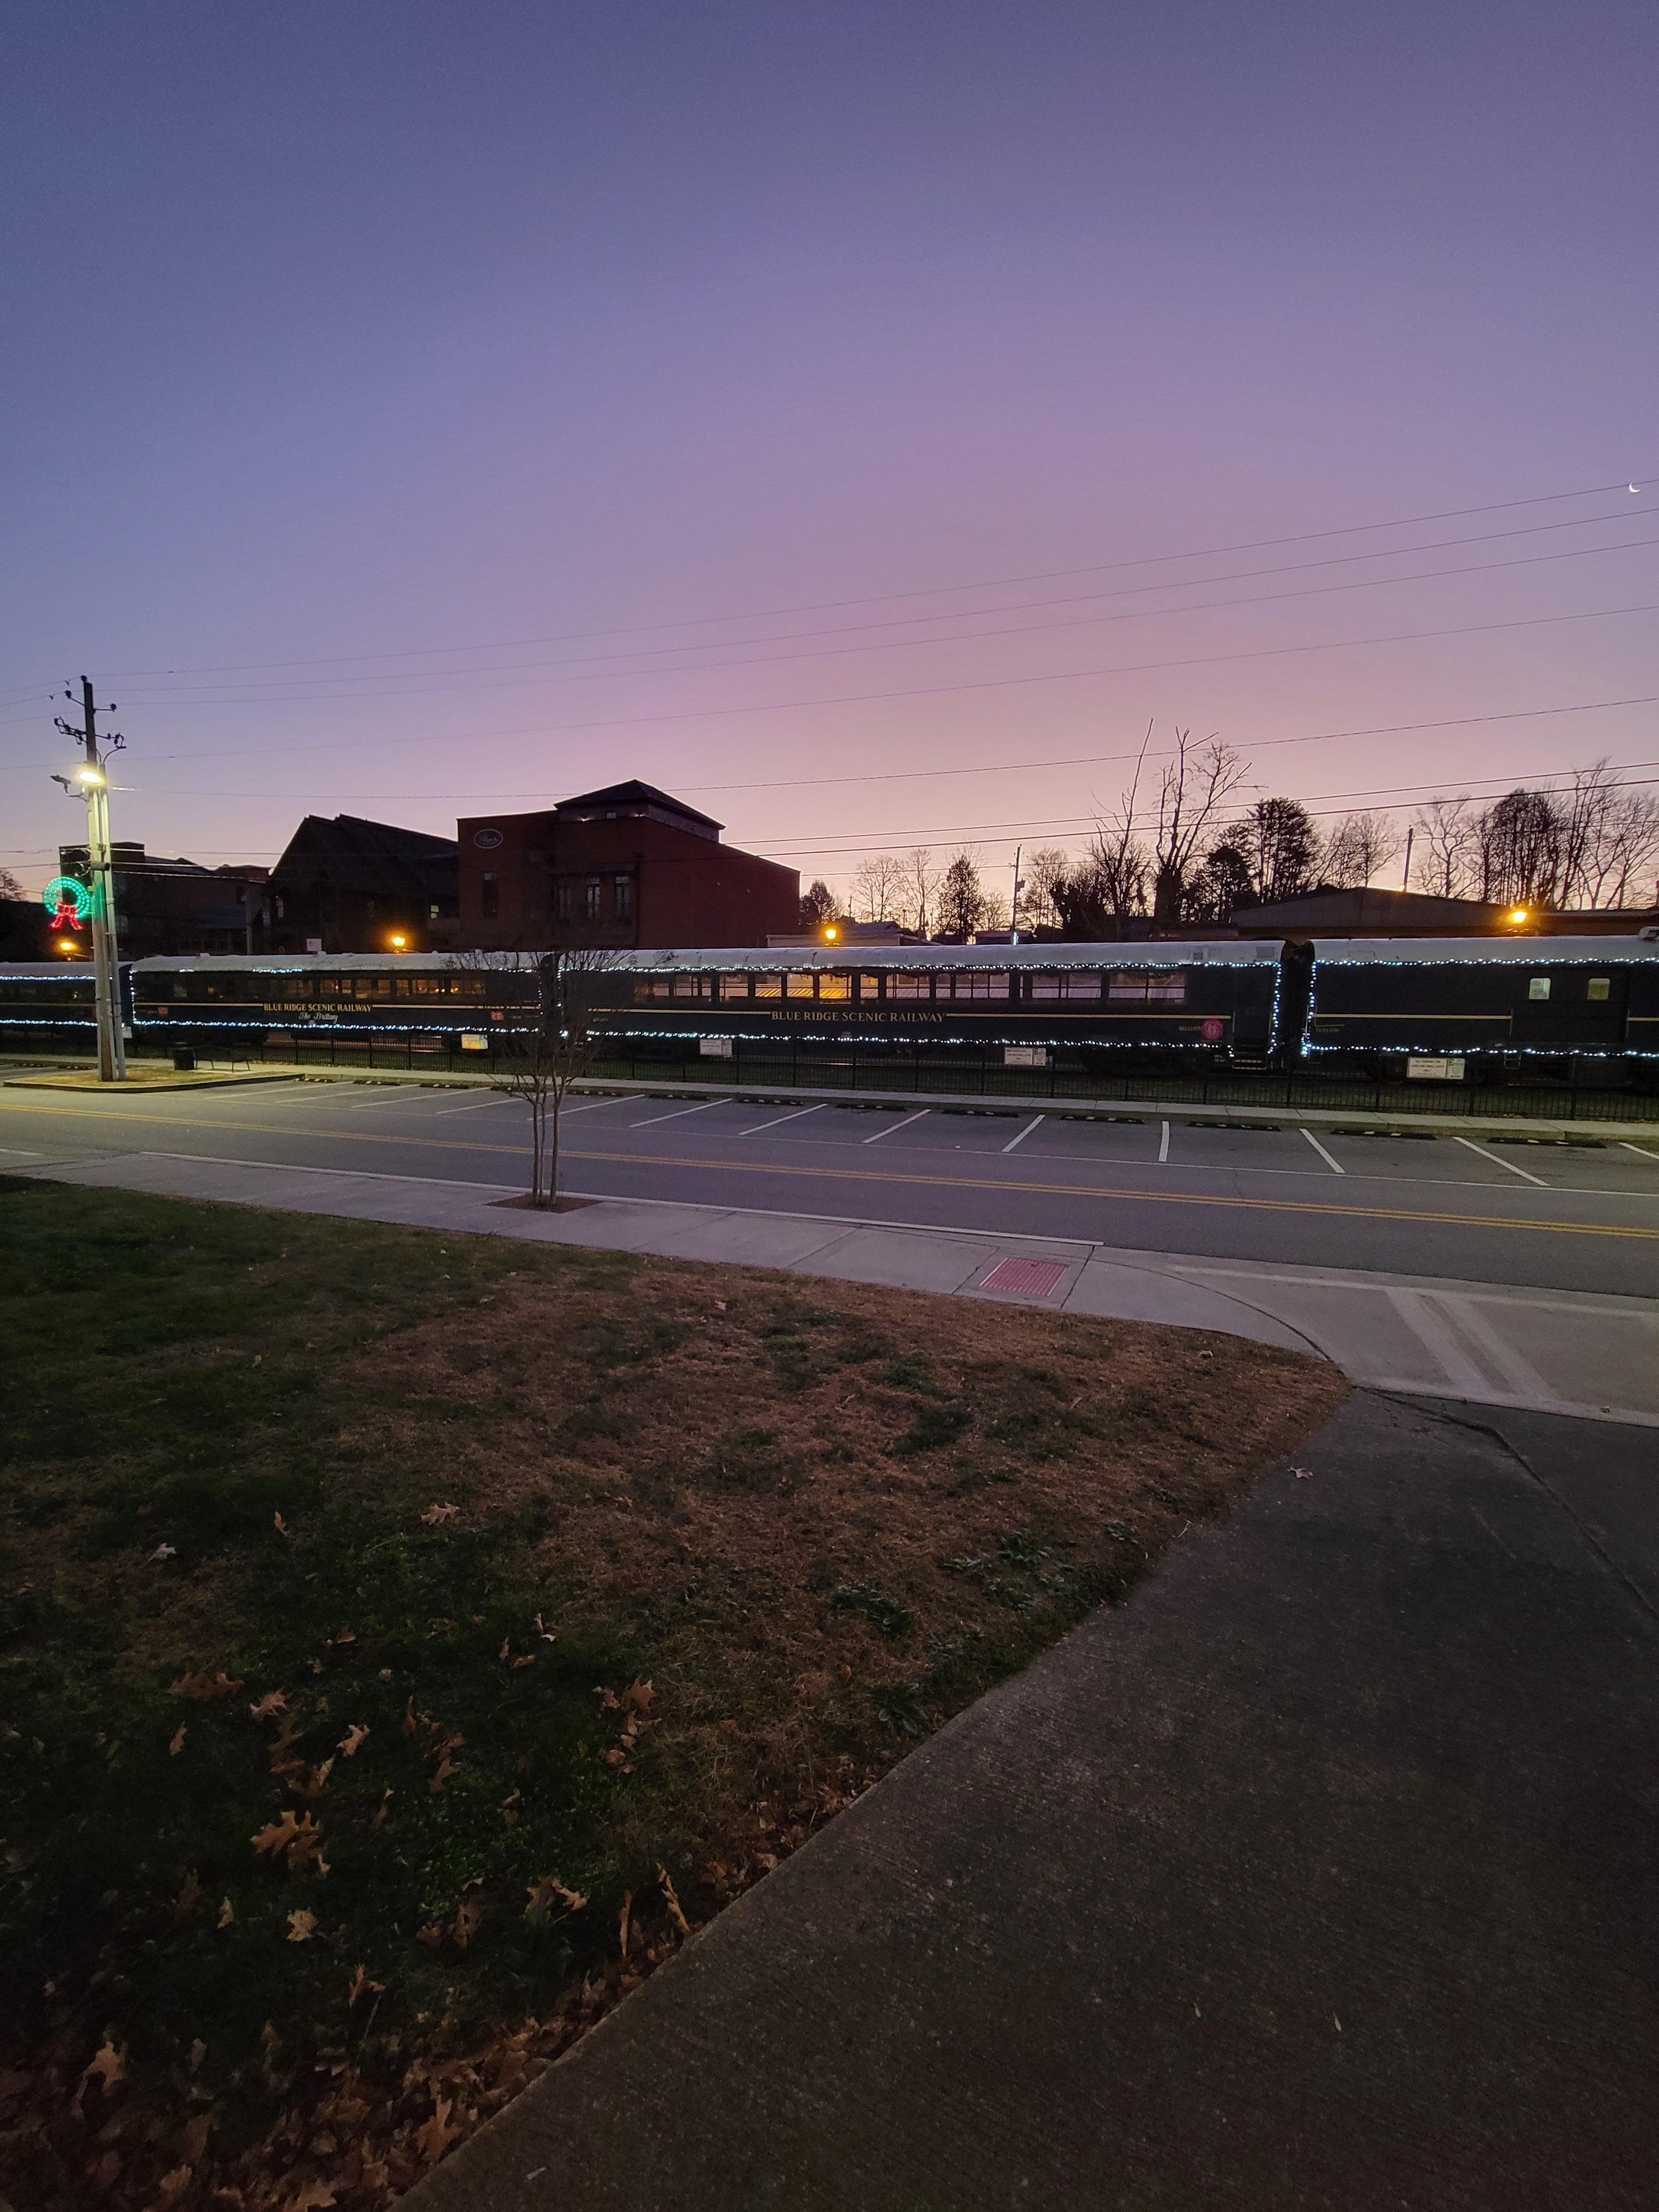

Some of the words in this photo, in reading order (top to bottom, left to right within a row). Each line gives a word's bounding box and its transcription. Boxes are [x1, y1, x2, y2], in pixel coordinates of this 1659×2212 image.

[771, 1011, 801, 1020] BLUE
[804, 1012, 839, 1021] RIDGE
[842, 1012, 886, 1022] SCENIC
[889, 1013, 945, 1022] RAILWAY
